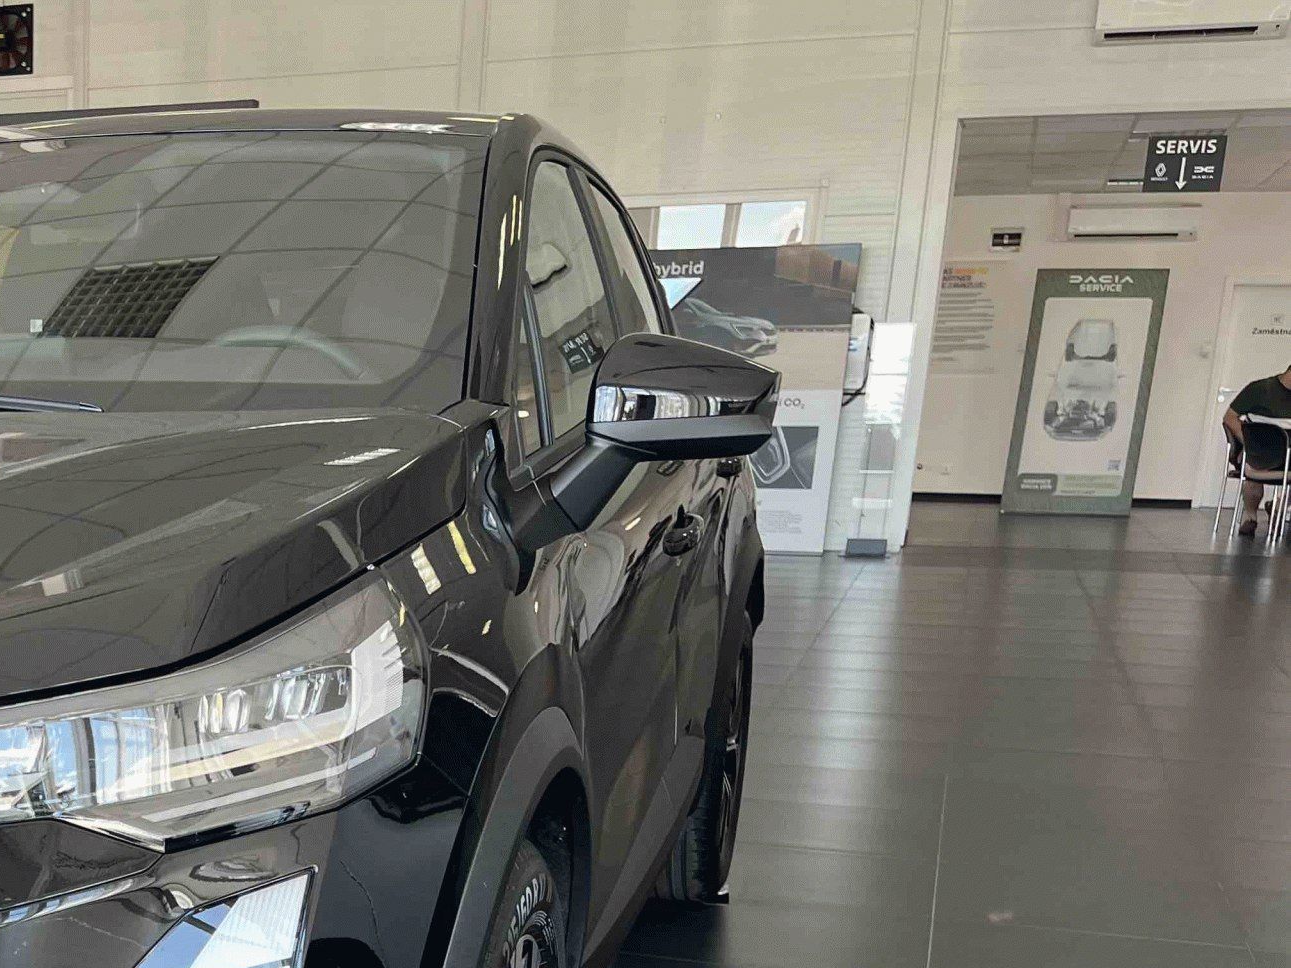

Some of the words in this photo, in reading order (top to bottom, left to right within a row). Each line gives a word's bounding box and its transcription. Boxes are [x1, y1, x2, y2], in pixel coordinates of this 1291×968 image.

[1155, 139, 1218, 155] SERVIS
[1069, 274, 1134, 284] DACIA
[1079, 283, 1123, 293] SERVICE
